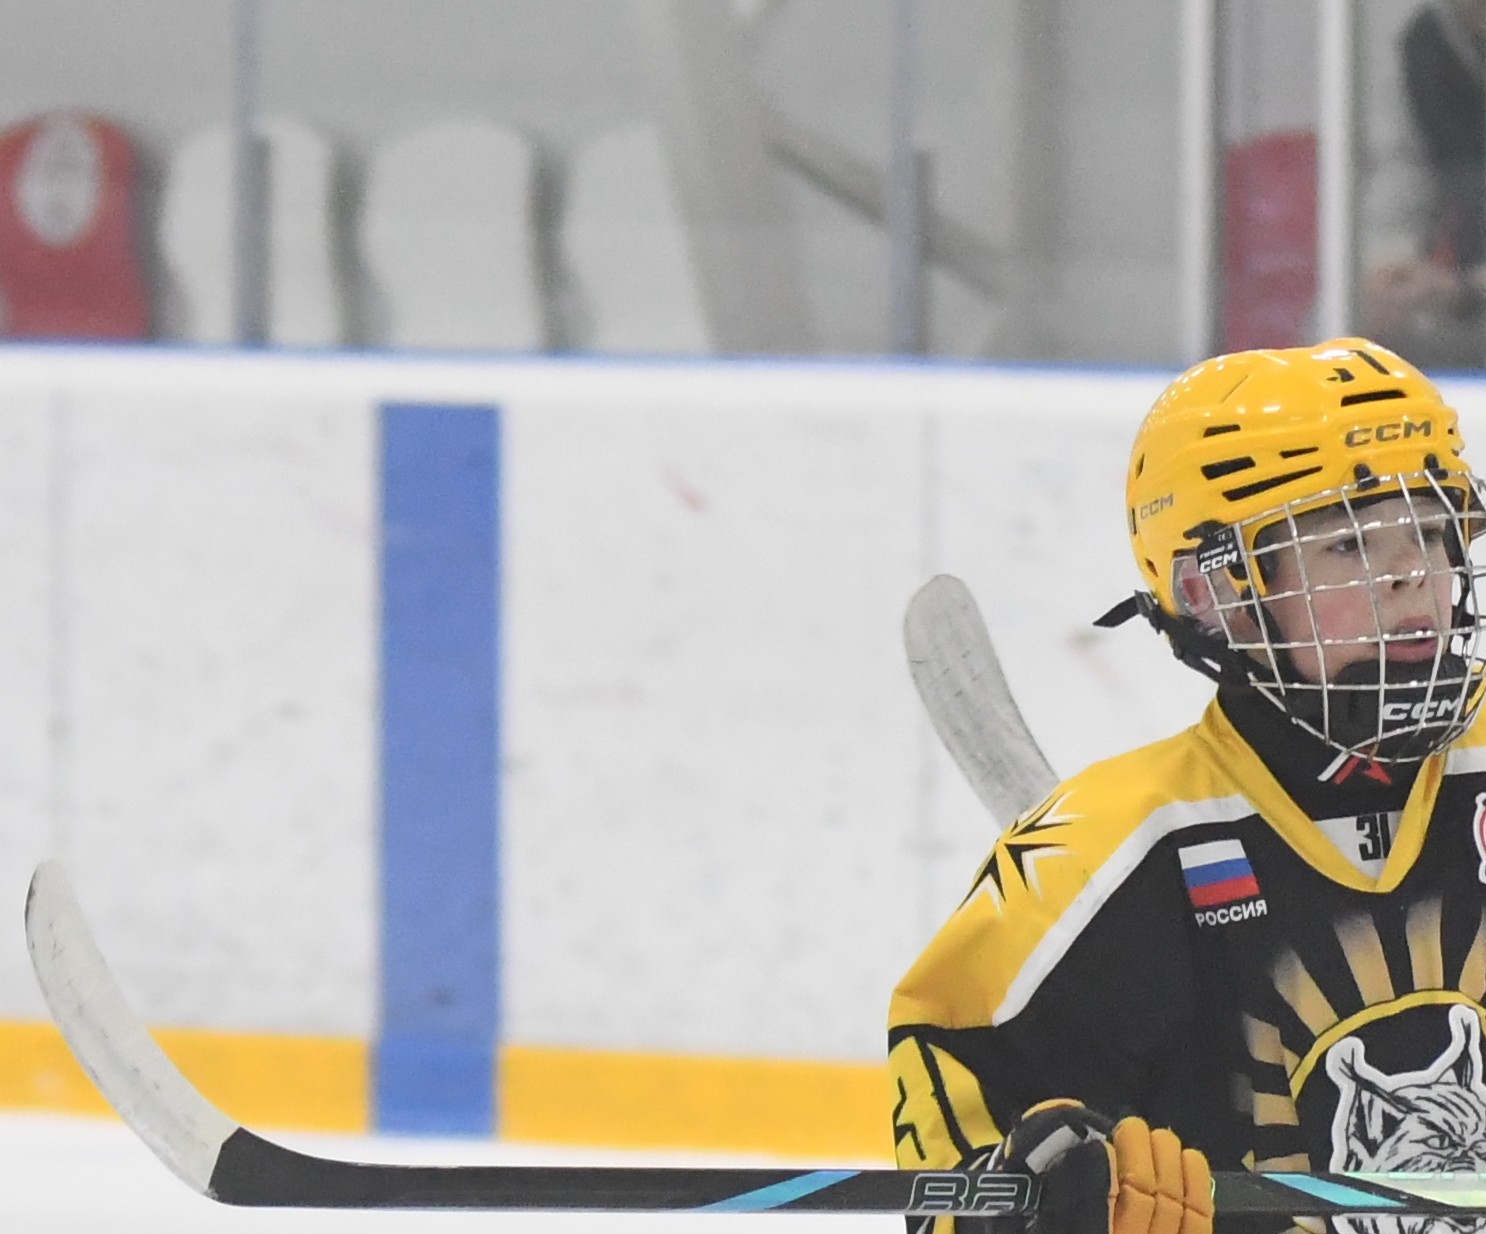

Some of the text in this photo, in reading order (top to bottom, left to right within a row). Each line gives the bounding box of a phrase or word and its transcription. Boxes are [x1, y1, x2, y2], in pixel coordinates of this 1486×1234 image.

[1345, 420, 1432, 448] CCM
[1140, 493, 1174, 520] CCM
[1199, 550, 1238, 573] CCM
[1383, 697, 1462, 720] CCM
[1356, 812, 1391, 862] 31
[1194, 899, 1268, 928] РОССИЯ
